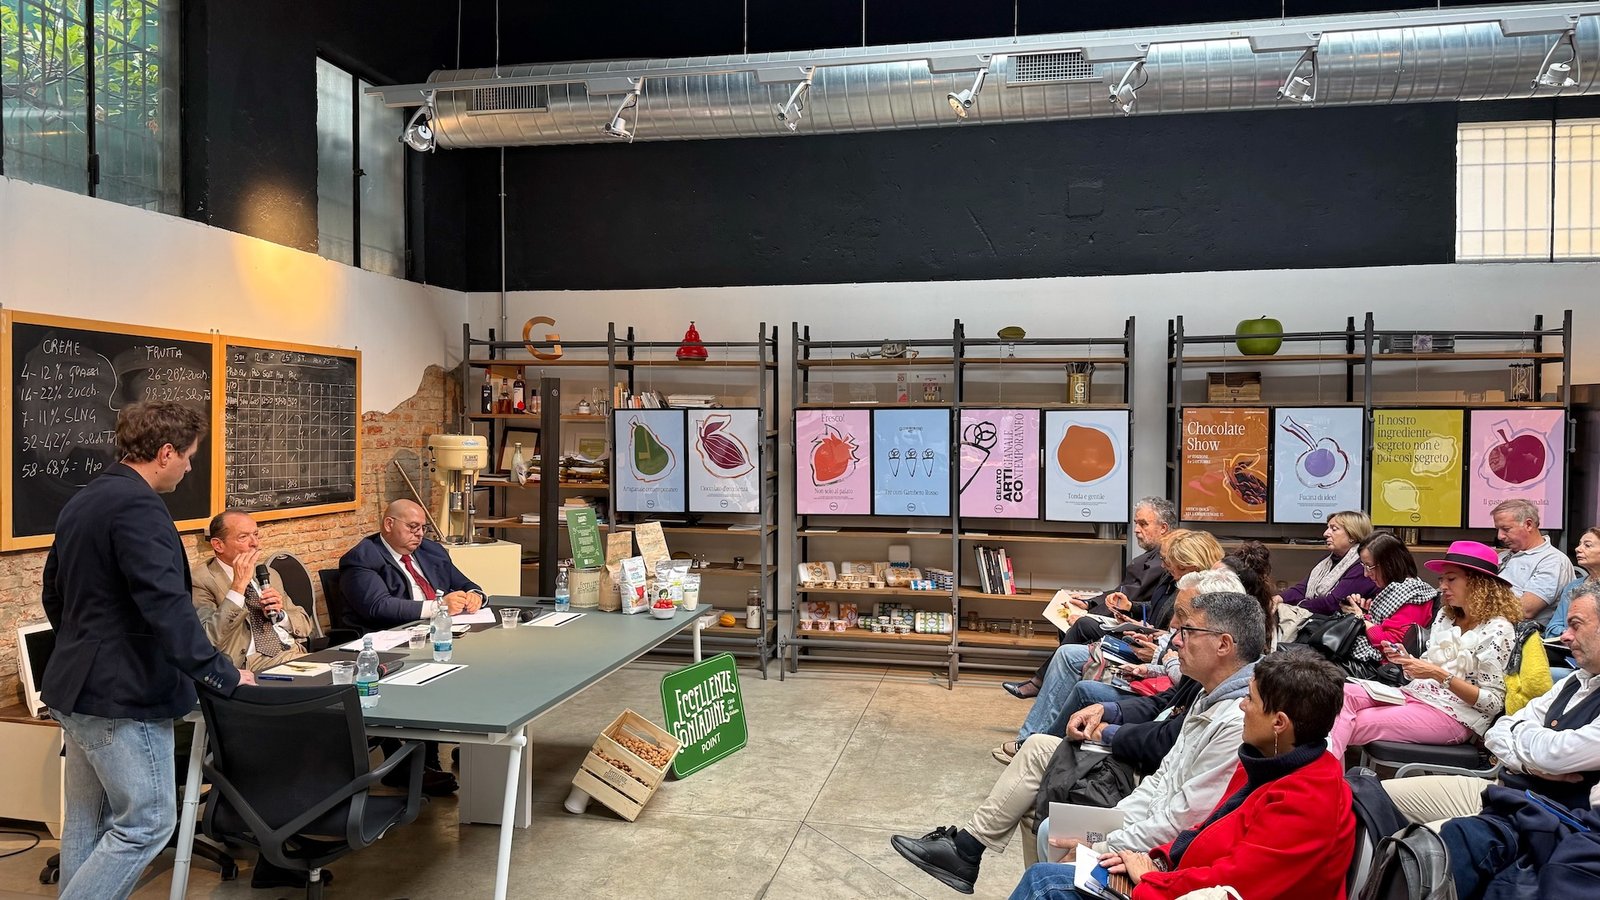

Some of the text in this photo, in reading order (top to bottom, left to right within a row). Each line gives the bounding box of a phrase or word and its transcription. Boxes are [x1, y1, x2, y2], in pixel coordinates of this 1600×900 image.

[42, 338, 81, 356] CREME
[145, 345, 183, 360] FRUTTA
[1386, 415, 1416, 425] nostro
[1187, 421, 1246, 436] Chocolate
[1377, 427, 1432, 440] ingrediente
[1187, 437, 1221, 451] Show
[1377, 440, 1411, 452] segreto
[1413, 442, 1432, 451] non
[1013, 412, 1024, 503] CONTEMPORANEO
[1377, 453, 1392, 465] poi
[1414, 453, 1451, 465] segreto.
[1003, 429, 1013, 503] ARTIGIANALE
[674, 670, 736, 725] ECCELLENZE
[673, 699, 731, 754] CONTADINE
[701, 732, 721, 754] POINT
